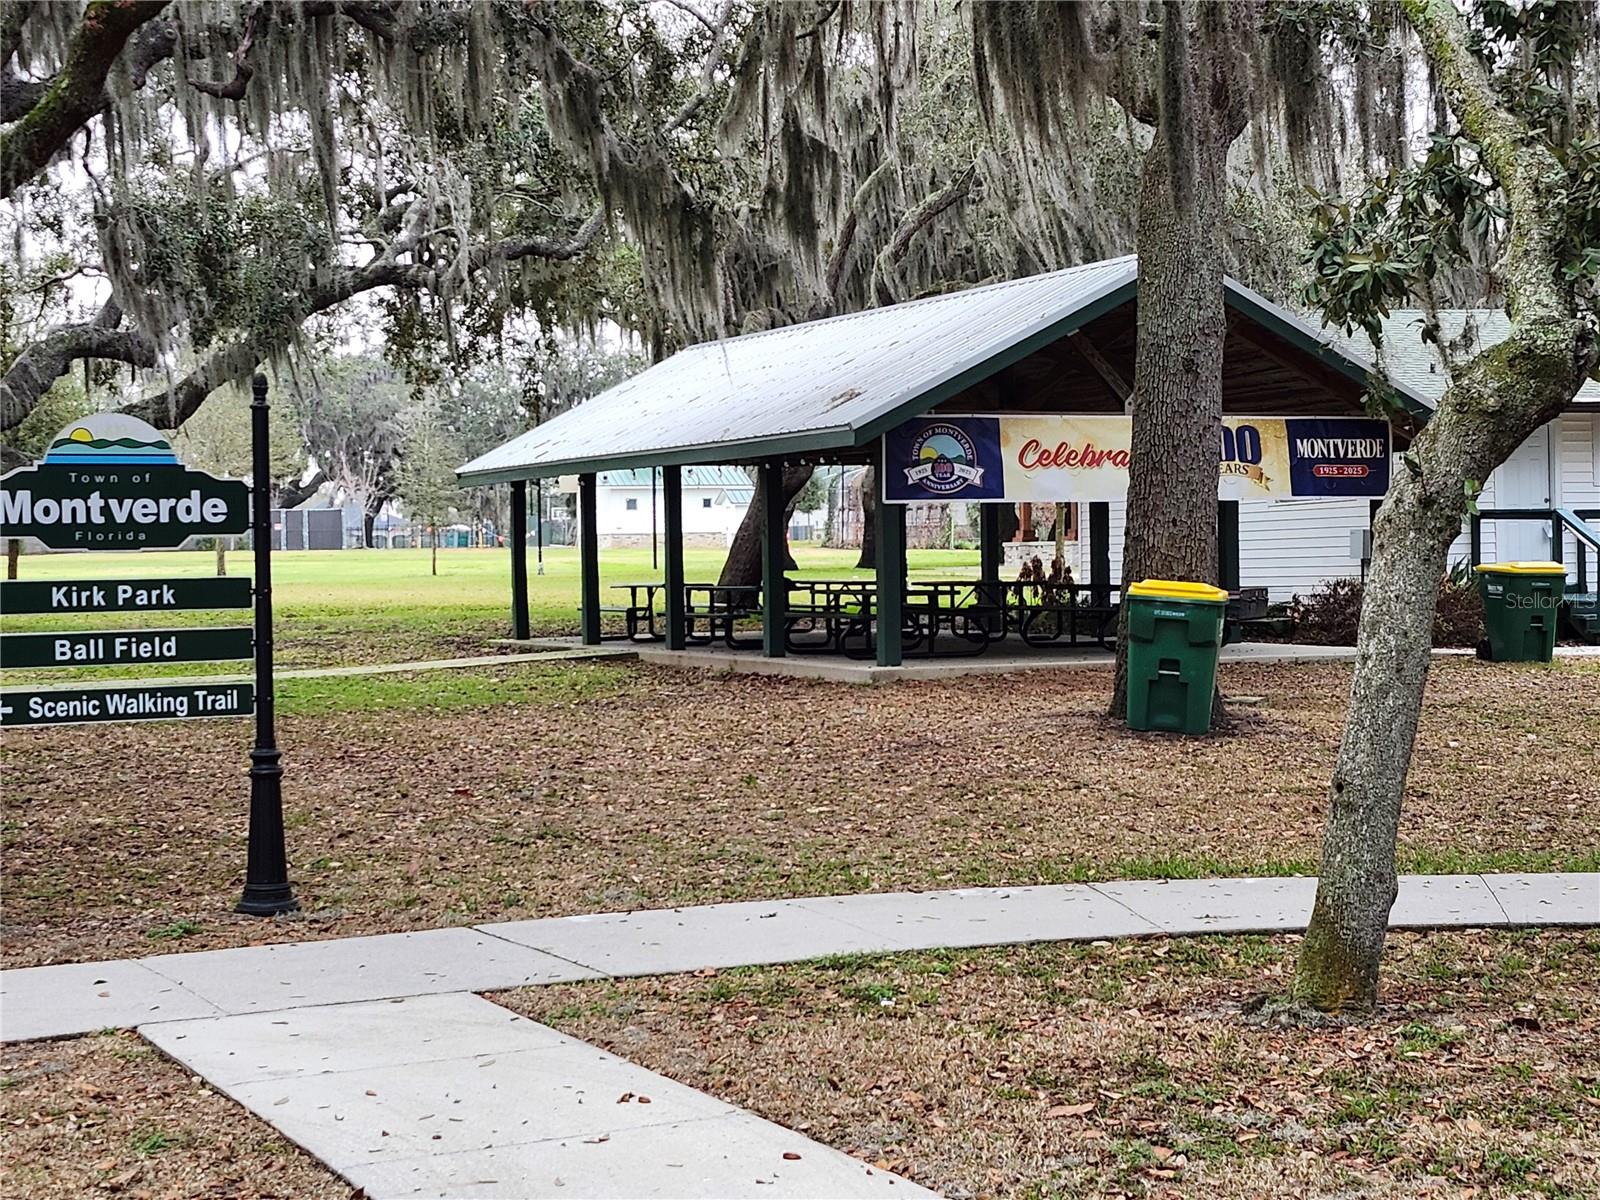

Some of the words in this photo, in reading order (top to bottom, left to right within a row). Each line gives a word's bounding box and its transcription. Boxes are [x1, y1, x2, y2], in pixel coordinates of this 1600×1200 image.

[923, 429, 934, 438] OF
[934, 427, 974, 460] MONTVERDE
[1296, 438, 1385, 459] MONTVERDE
[68, 472, 119, 483] Town
[131, 472, 151, 483] of
[0, 490, 228, 524] Montverde
[75, 531, 147, 541] Florida
[52, 585, 106, 607] Kirk
[117, 584, 176, 605] Park
[55, 639, 104, 660] Ball
[115, 636, 176, 658] Field
[28, 696, 101, 718] Scenic
[105, 692, 189, 716] Walking
[194, 690, 238, 710] Trail
